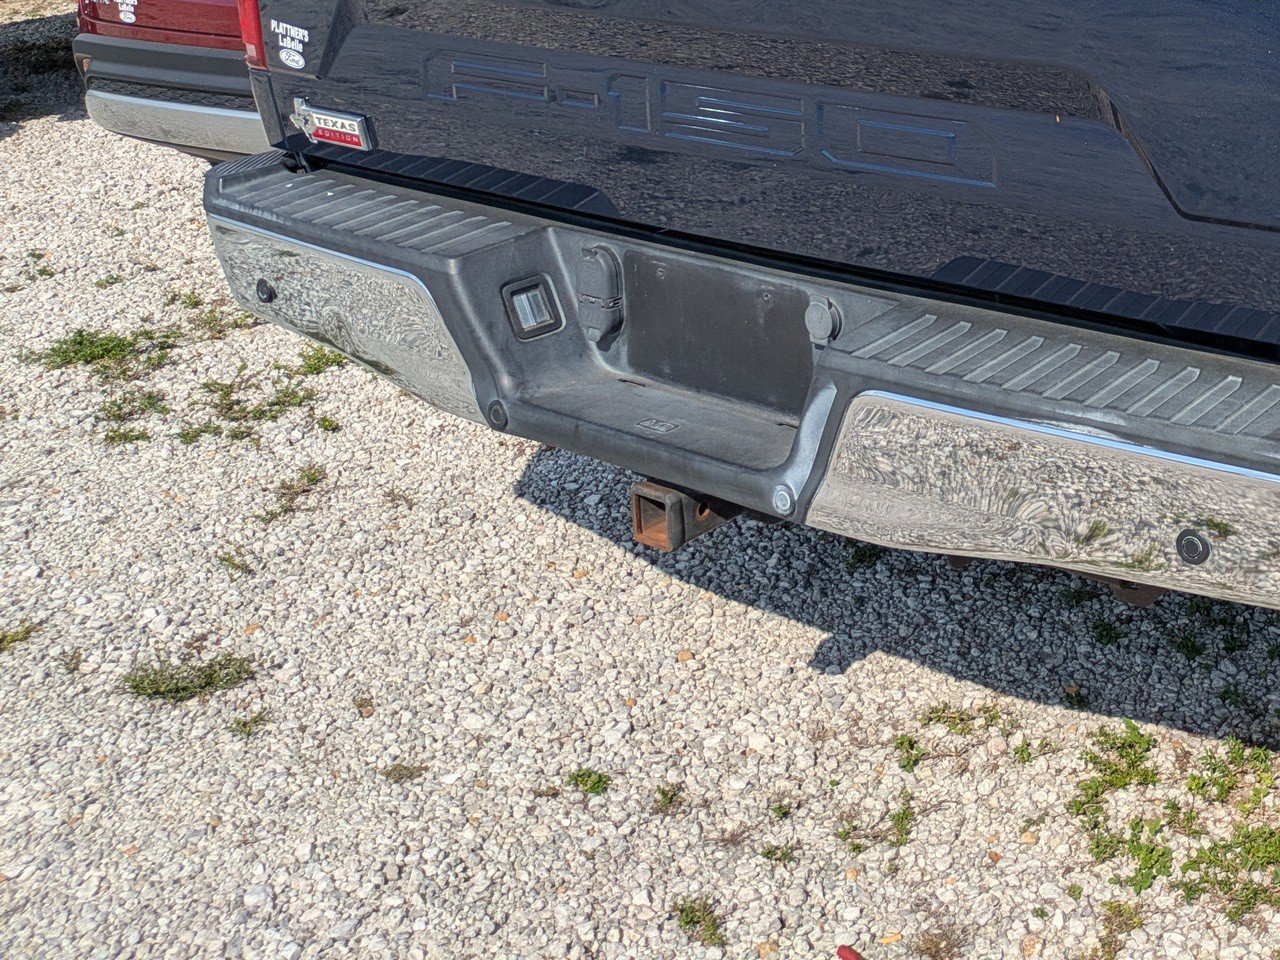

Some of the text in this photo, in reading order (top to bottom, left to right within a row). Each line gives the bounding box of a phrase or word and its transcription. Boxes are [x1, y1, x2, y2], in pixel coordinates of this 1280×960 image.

[271, 19, 309, 42] PLATTNER'S
[315, 116, 357, 132] TEXAS
[422, 45, 997, 188] F-150
[318, 129, 359, 143] EDITION
